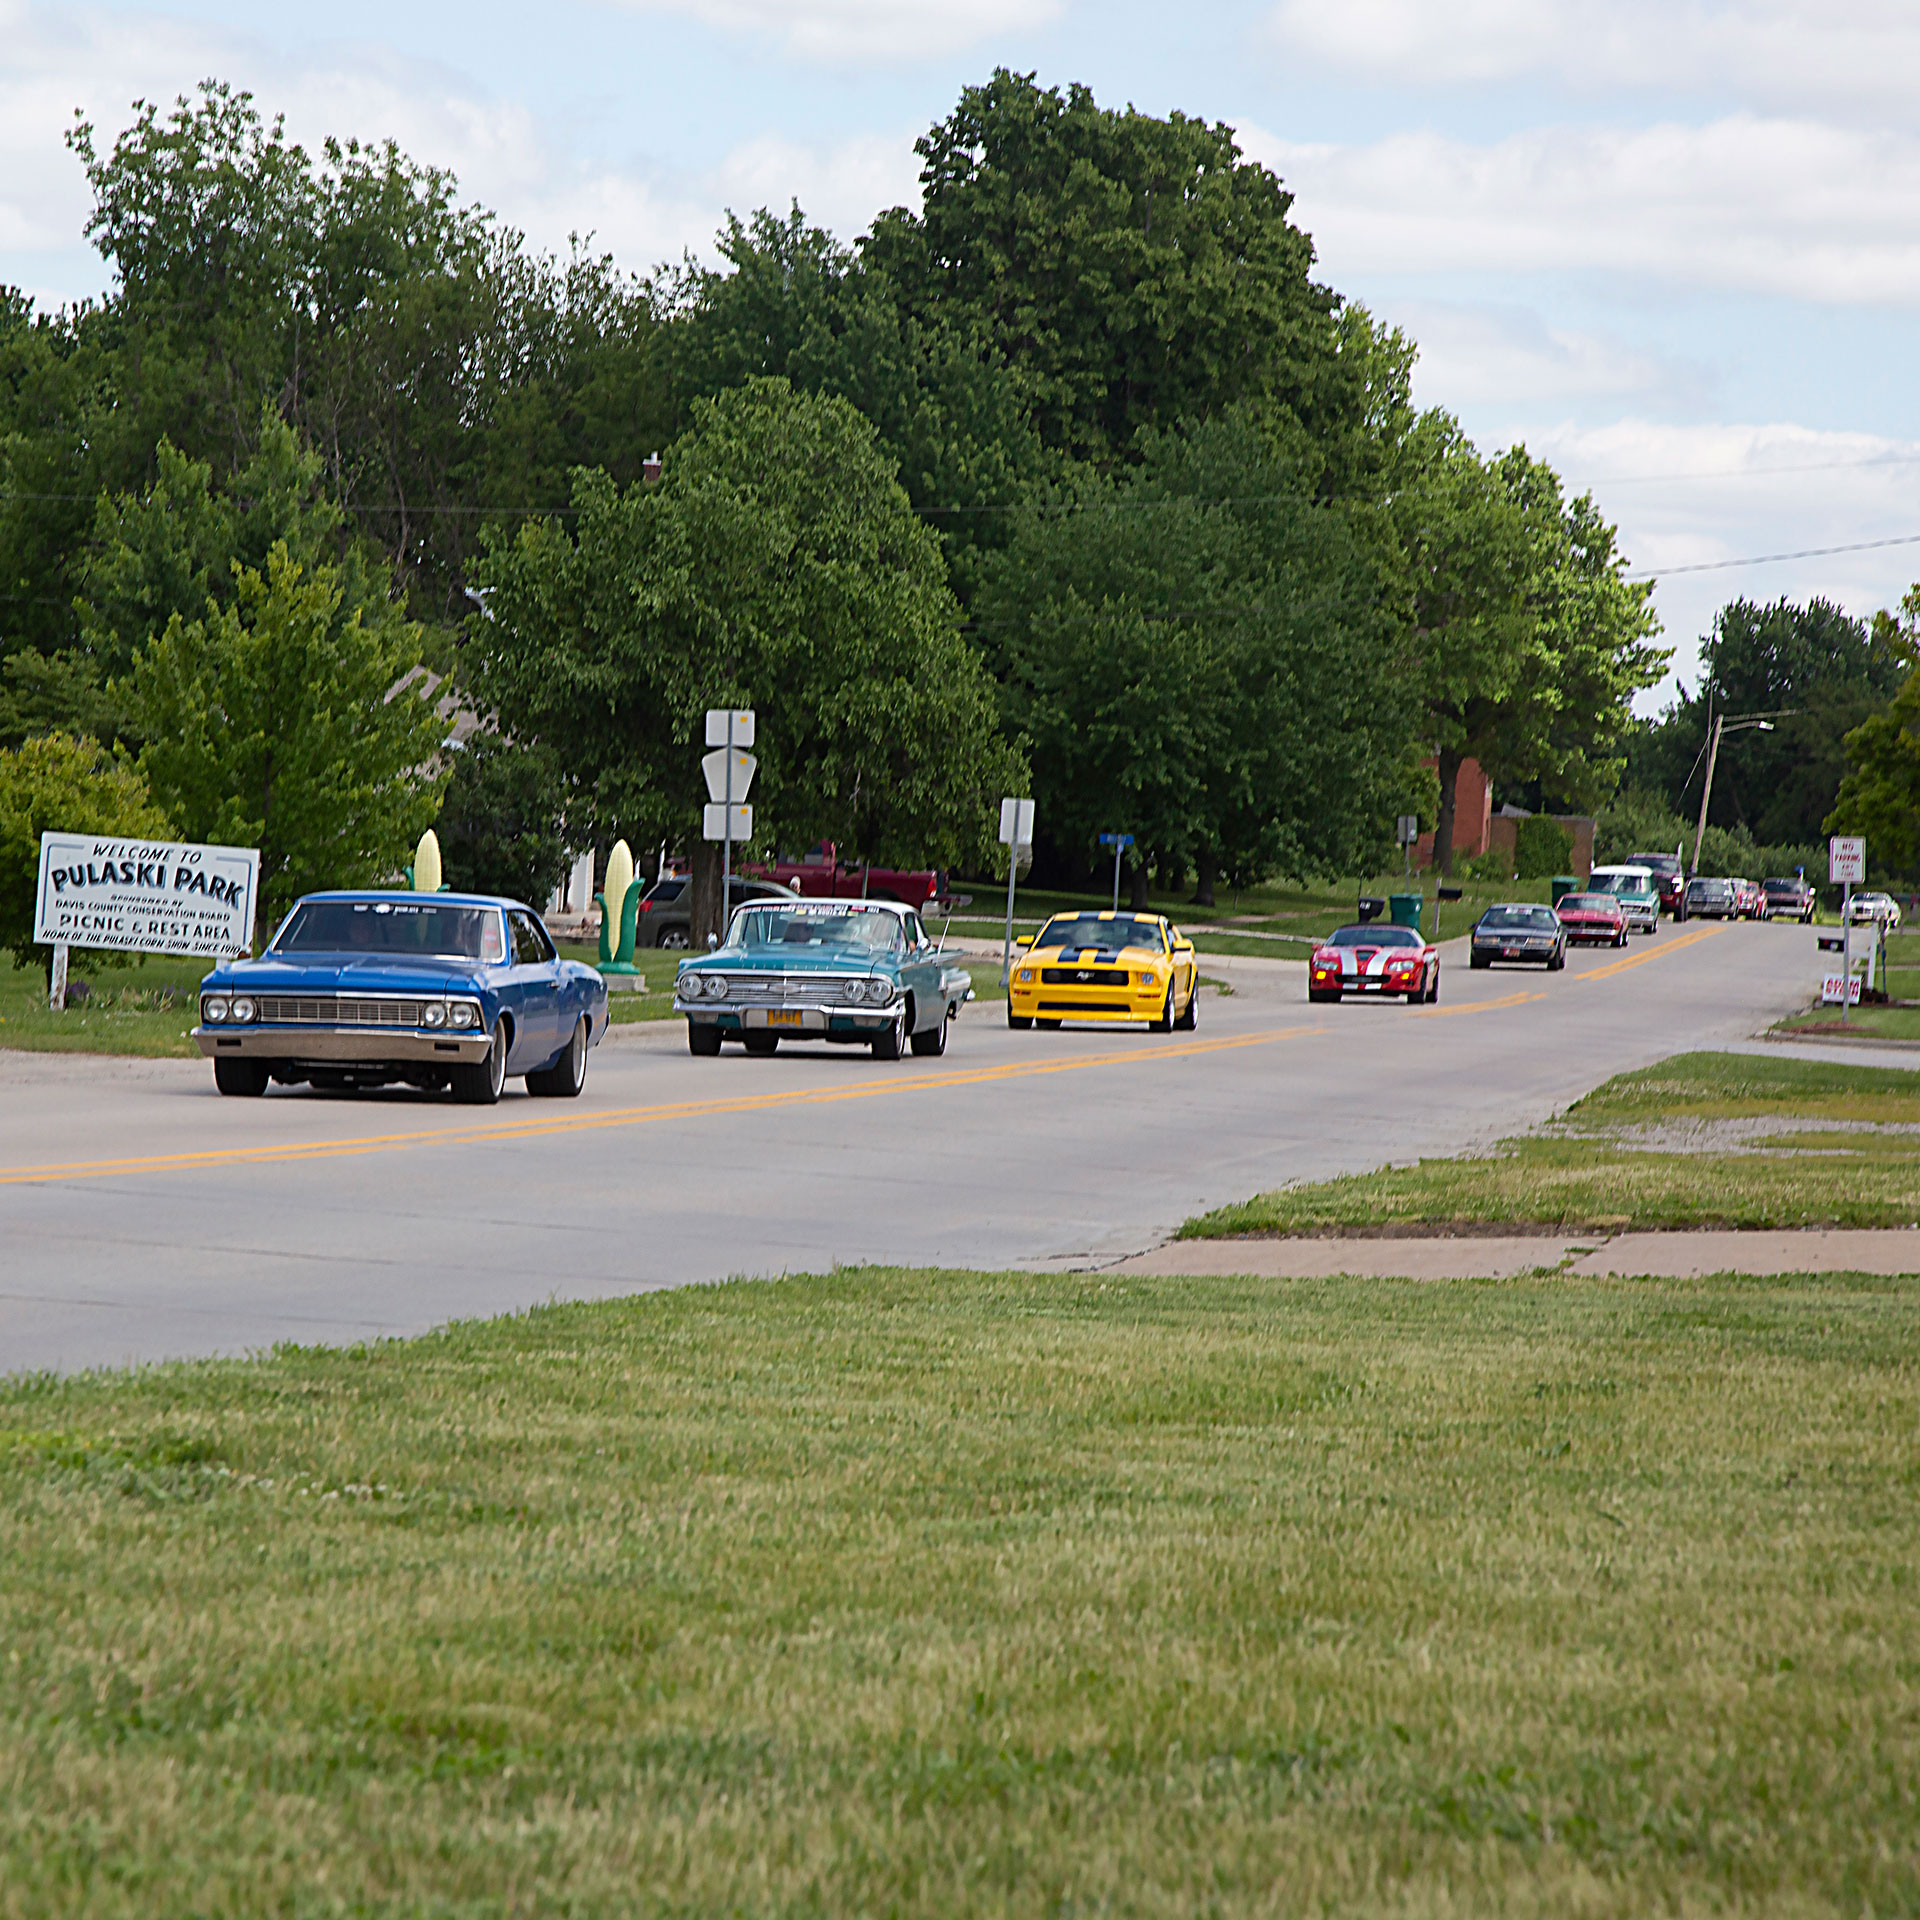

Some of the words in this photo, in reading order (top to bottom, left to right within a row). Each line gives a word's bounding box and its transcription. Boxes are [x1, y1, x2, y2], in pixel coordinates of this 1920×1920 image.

[92, 843, 175, 862] WELCOME
[180, 849, 202, 865] TO
[1834, 854, 1860, 862] PARKING
[1842, 843, 1854, 851] NO
[51, 861, 167, 893] PULASKI
[173, 867, 244, 911] PARK
[55, 899, 85, 910] DAVIS
[88, 901, 124, 914] COUNTY
[127, 905, 196, 920] CONSERVATION
[199, 911, 231, 922] BOARD
[110, 893, 168, 906] SPONSORED
[172, 899, 184, 908] BY
[59, 913, 125, 931] PICNIC
[132, 921, 143, 934] &
[148, 921, 189, 937] REST
[193, 924, 230, 941] AREA
[41, 929, 70, 941] HOME
[71, 931, 84, 942] OF
[86, 932, 102, 942] THE
[103, 935, 139, 946] PULASKI
[139, 937, 165, 949] CORN
[165, 940, 191, 951] SHOW
[191, 941, 219, 953] SINCE
[220, 944, 241, 955] 1910
